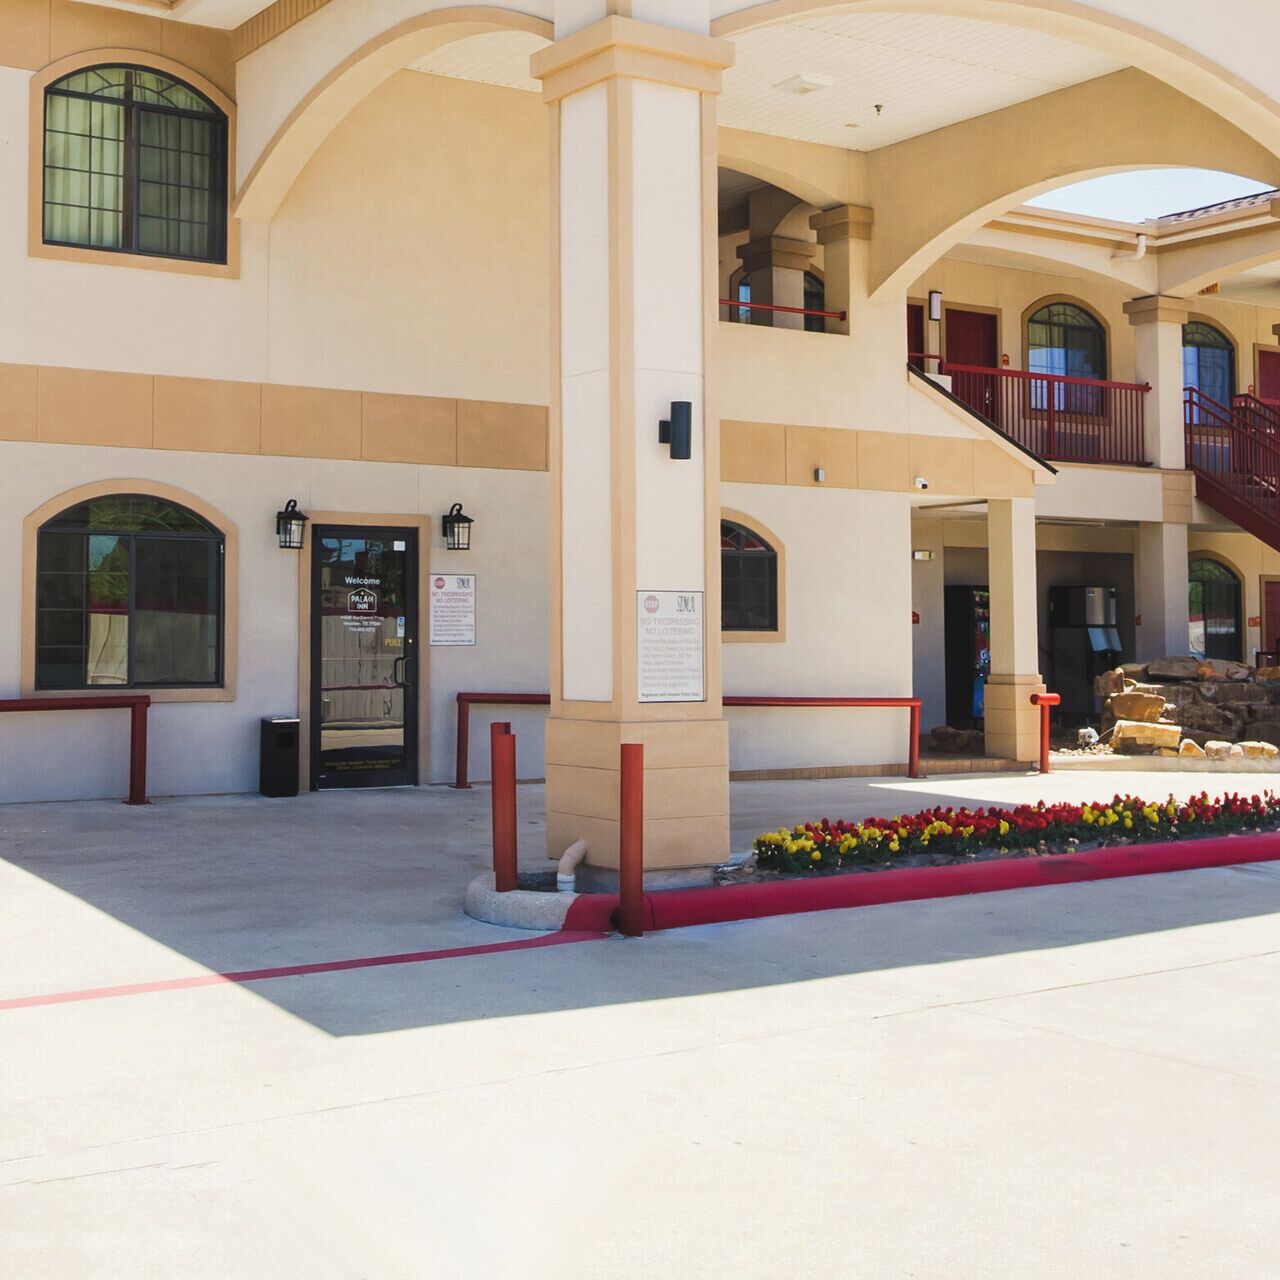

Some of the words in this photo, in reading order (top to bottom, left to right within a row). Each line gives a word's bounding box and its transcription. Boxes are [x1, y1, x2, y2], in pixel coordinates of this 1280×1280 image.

[344, 576, 381, 585] Welcome
[640, 617, 650, 625] NO
[653, 617, 700, 626] TRESPASSING
[646, 627, 656, 635] NO
[658, 627, 695, 636] LOITERING
[384, 638, 401, 647] PULL
